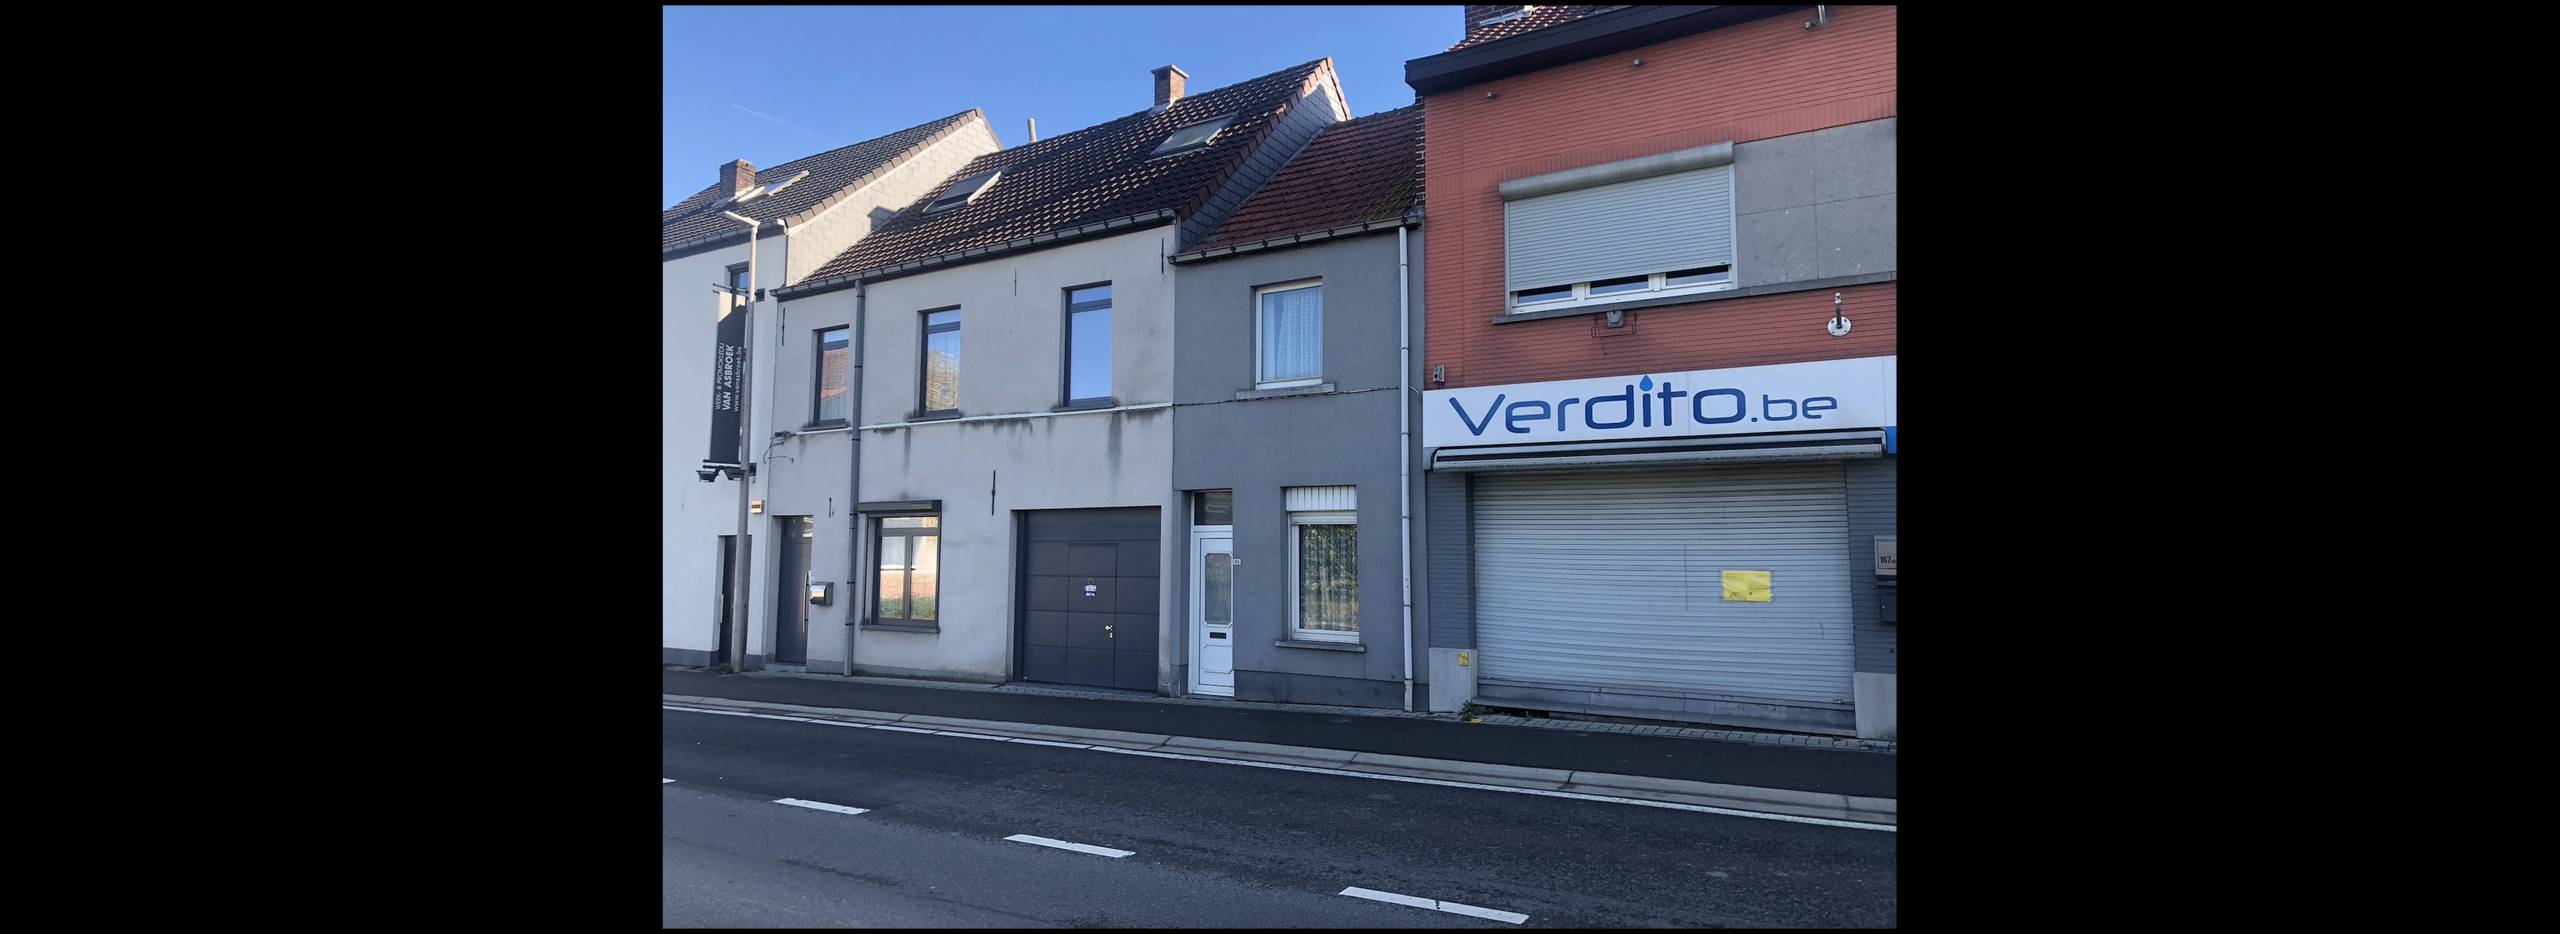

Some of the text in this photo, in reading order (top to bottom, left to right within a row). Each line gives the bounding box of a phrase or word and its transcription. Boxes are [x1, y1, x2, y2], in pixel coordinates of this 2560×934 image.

[722, 344, 734, 411] VAN ASBROEK
[734, 346, 742, 412] www.vanasbroek.be
[1448, 374, 1838, 437] Verdito.be
